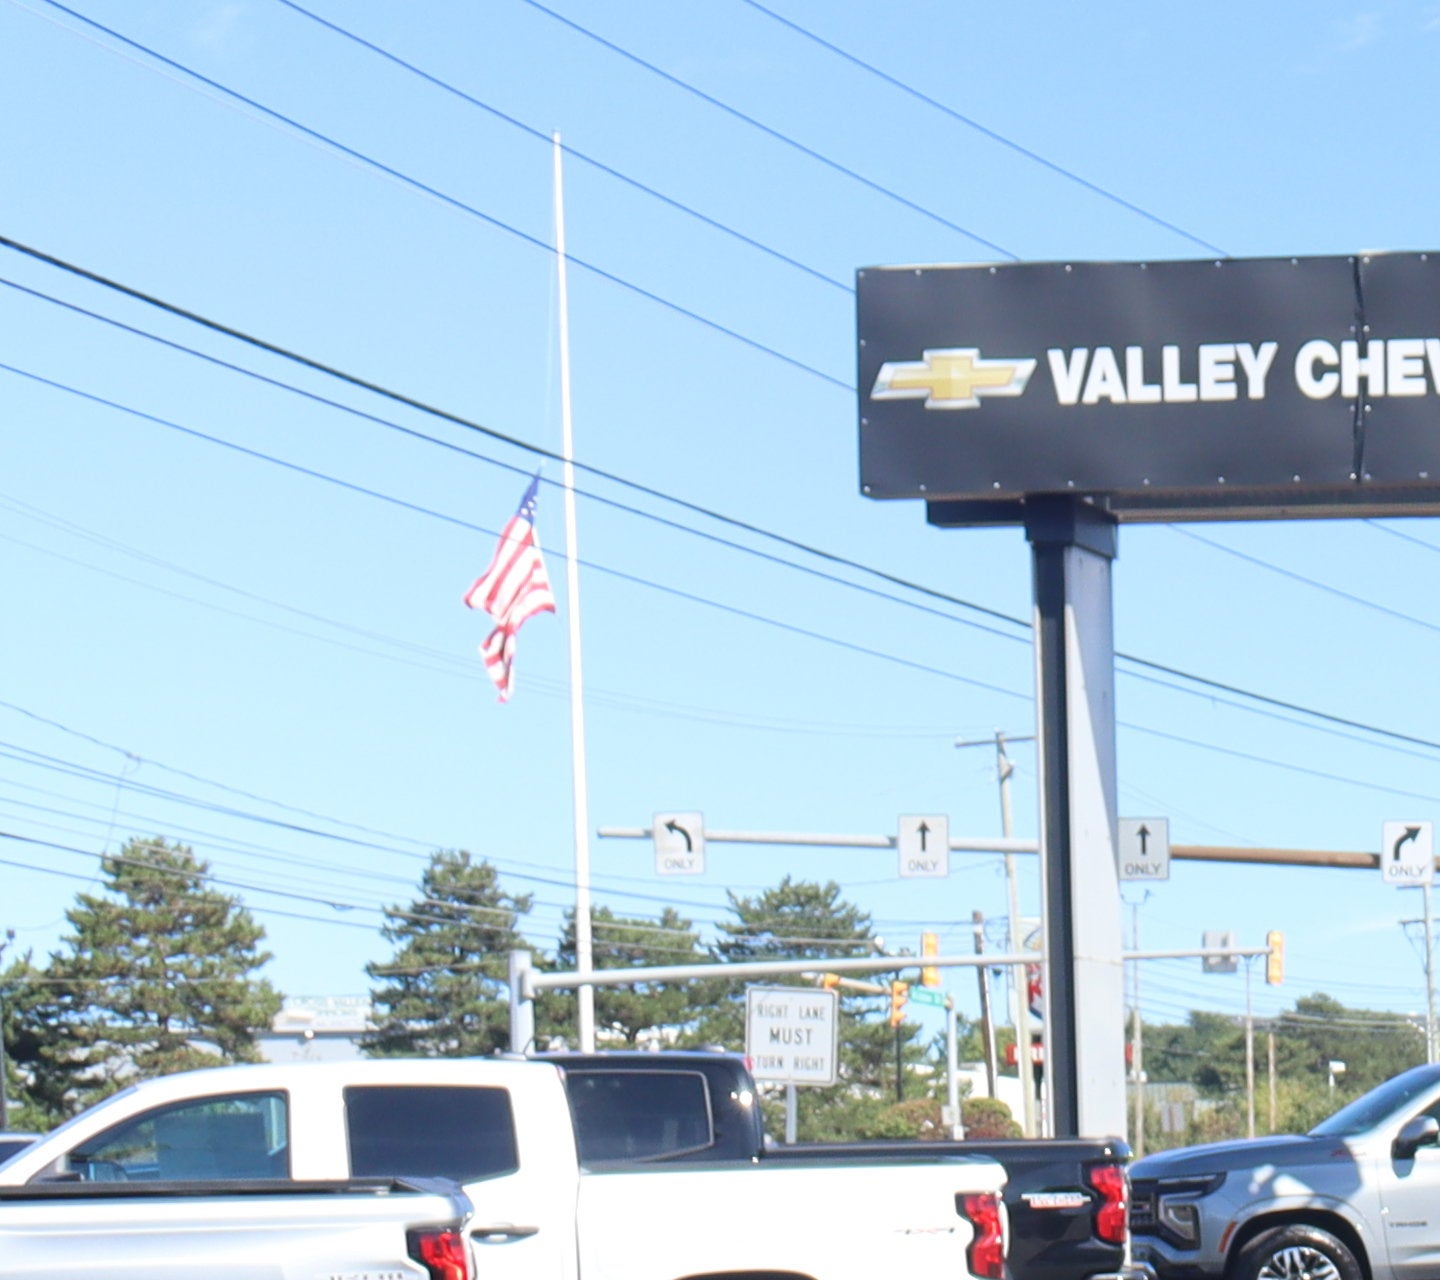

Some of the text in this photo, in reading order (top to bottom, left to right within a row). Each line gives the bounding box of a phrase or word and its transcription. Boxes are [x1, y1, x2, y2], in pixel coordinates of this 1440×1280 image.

[1047, 341, 1278, 404] VALLEY
[664, 857, 695, 871] ONLY
[907, 858, 939, 873] ONLY
[1124, 861, 1162, 877] ONLY
[1388, 863, 1426, 878] ONLY
[757, 1003, 826, 1021] RIGHT LANE
[769, 1026, 815, 1045] MUST
[756, 1055, 824, 1071] TURN RIGHT
